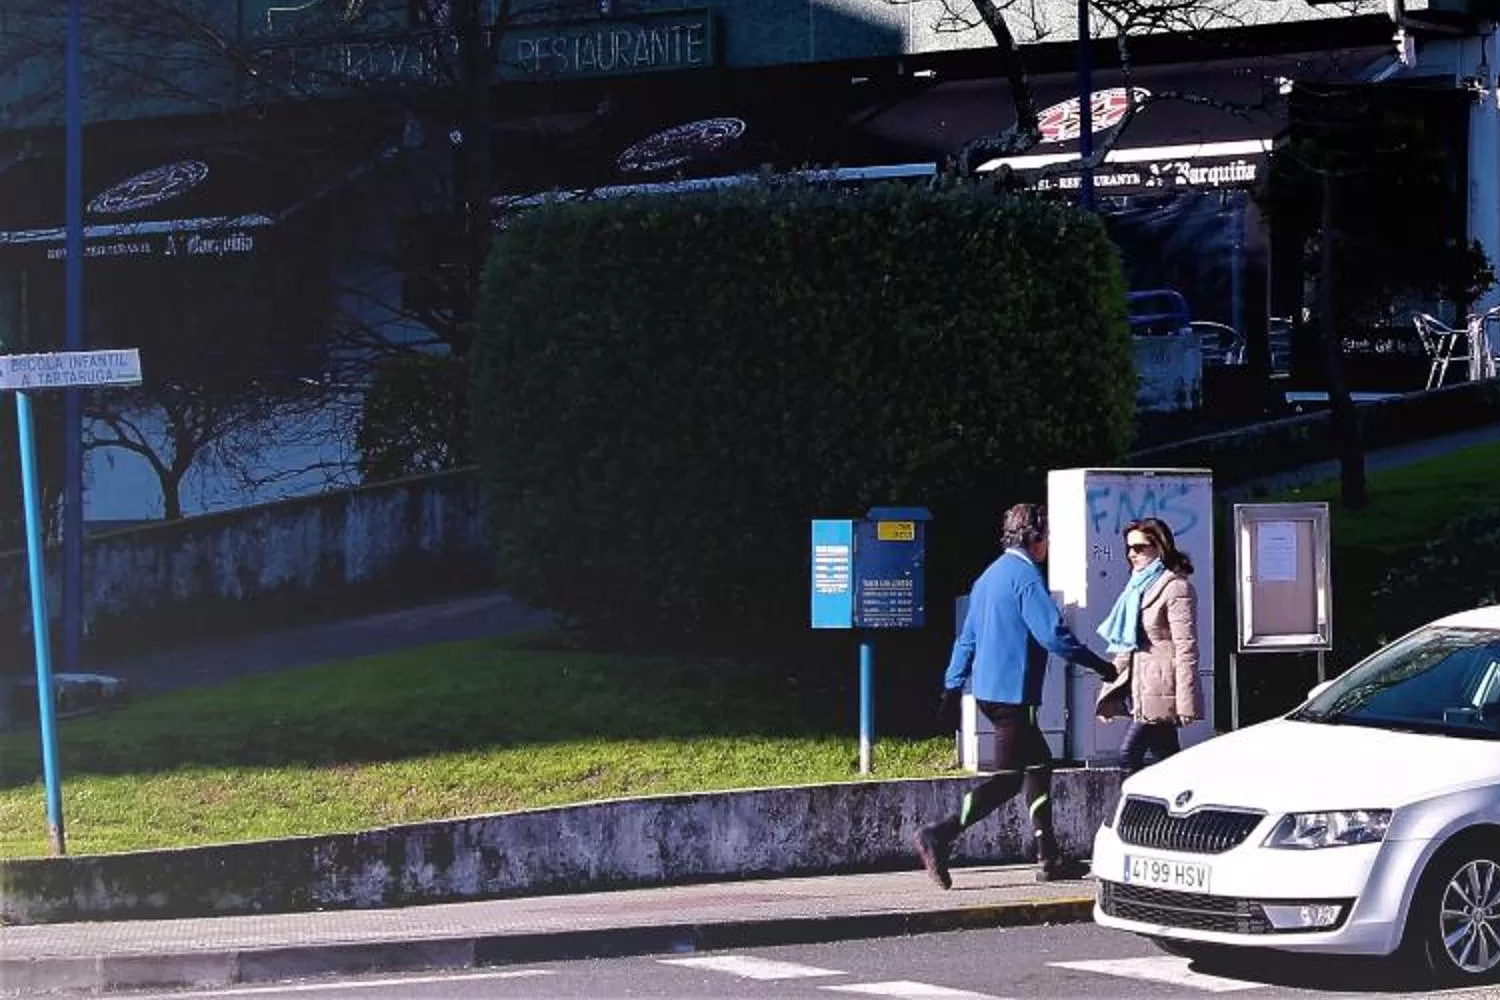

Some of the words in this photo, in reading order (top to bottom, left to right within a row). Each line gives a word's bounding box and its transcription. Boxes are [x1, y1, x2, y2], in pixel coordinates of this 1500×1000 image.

[66, 353, 129, 368] INFANTIL
[1133, 859, 1170, 883] 4199
[1175, 864, 1205, 888] HSV
